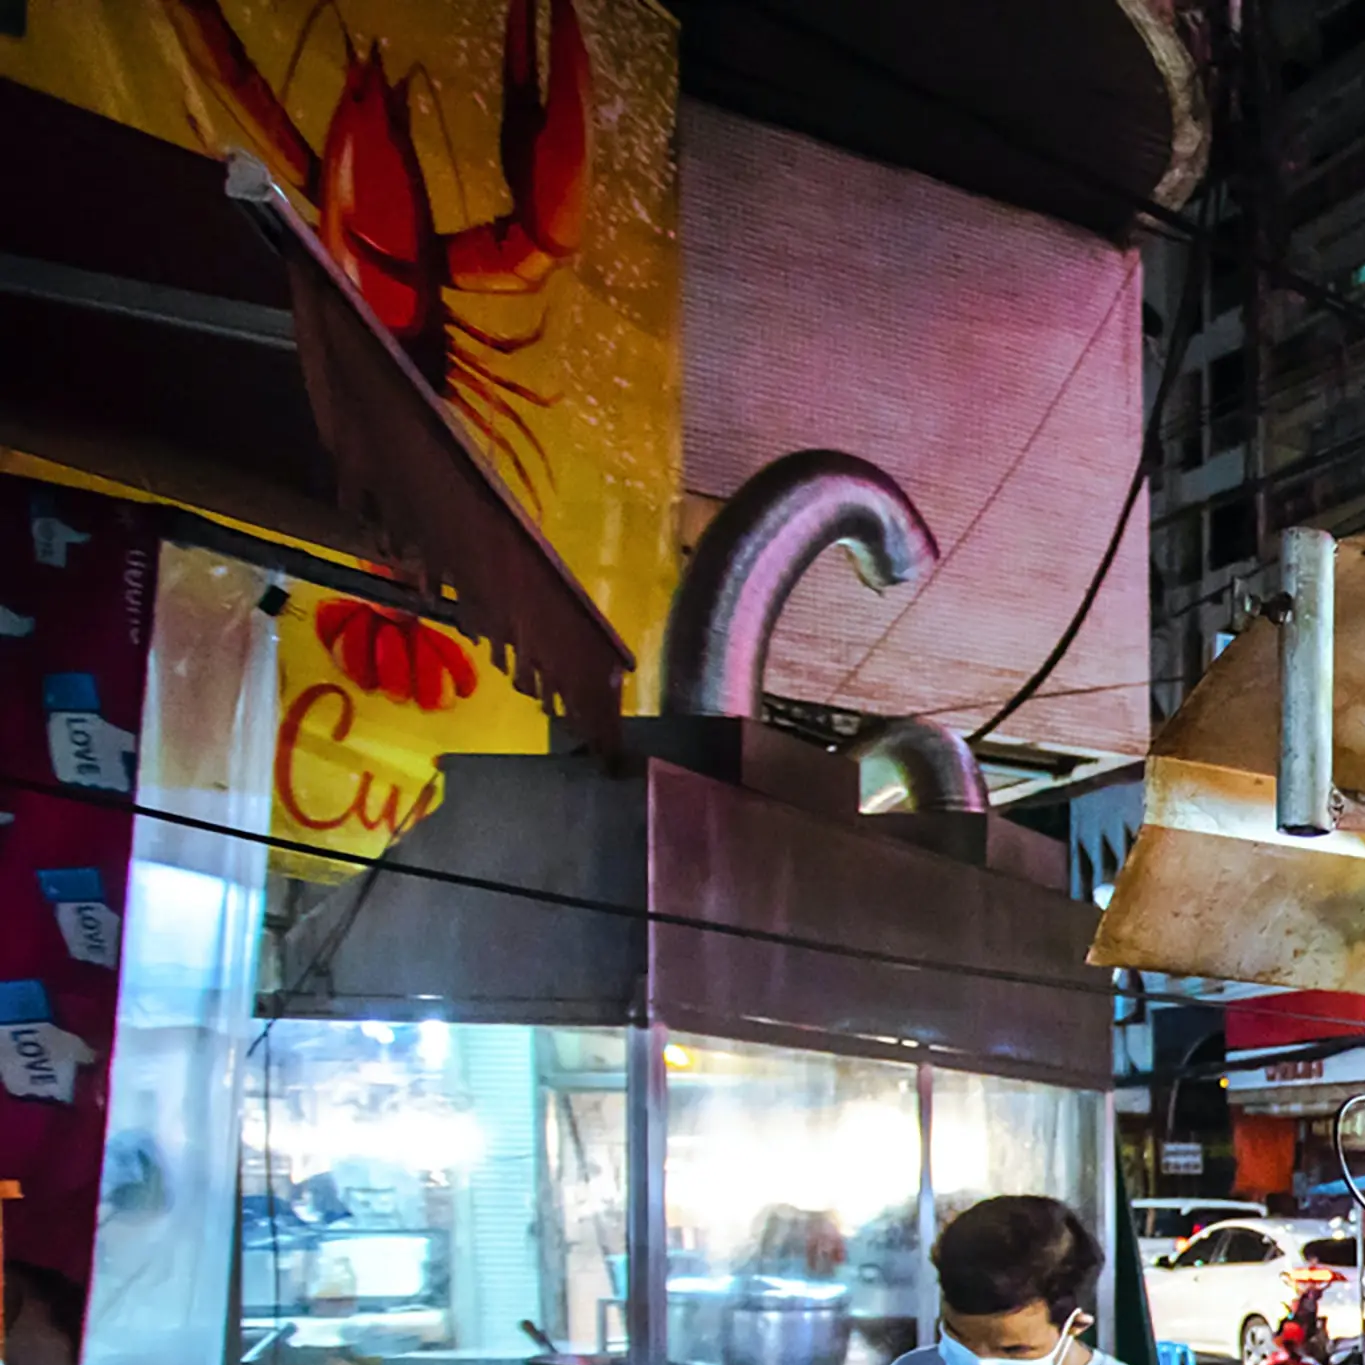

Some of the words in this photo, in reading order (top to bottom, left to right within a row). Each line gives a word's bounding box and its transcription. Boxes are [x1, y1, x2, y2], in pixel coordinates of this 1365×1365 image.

[67, 717, 101, 776] LOVE
[75, 906, 106, 959] LOVE
[11, 1029, 57, 1087] LOVE
